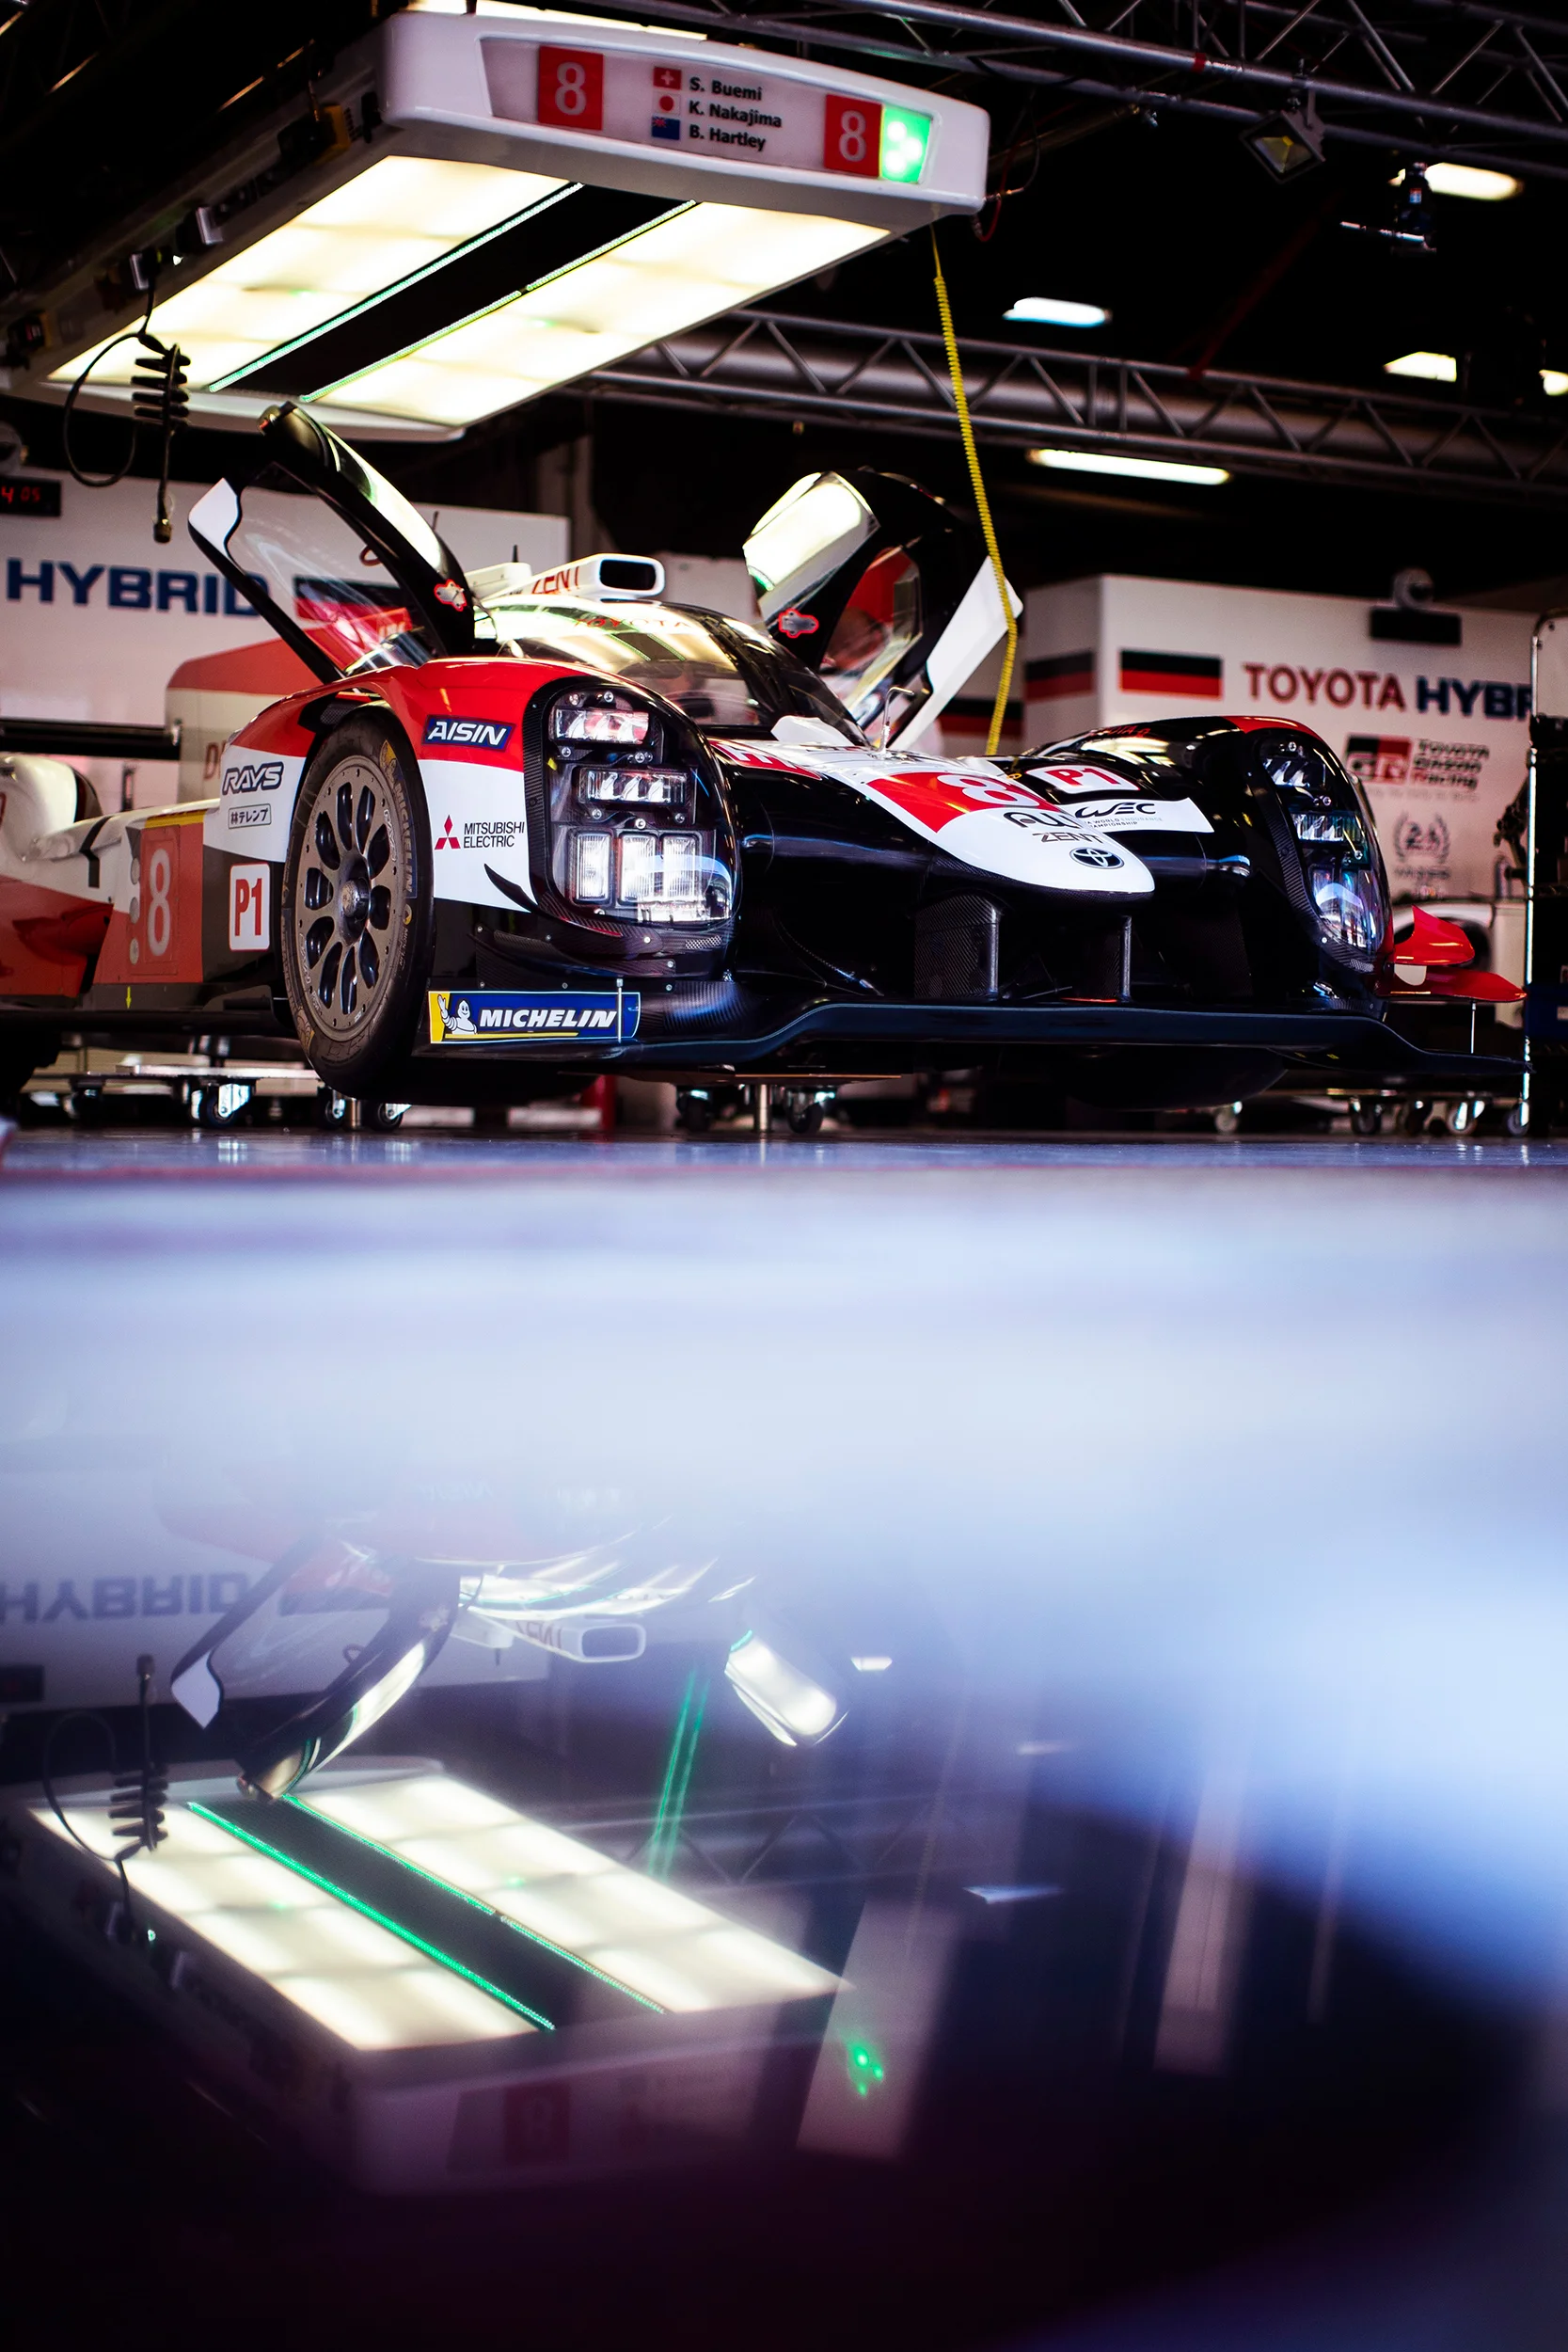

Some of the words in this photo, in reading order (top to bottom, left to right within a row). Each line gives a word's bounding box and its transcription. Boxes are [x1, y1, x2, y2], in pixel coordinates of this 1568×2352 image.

[554, 61, 587, 117] 8
[689, 76, 705, 92] S.
[711, 80, 763, 101] Buemi
[689, 101, 705, 116] K.
[709, 103, 783, 128] Nakajima
[689, 124, 705, 139] B.
[709, 127, 766, 151] Hartley
[838, 109, 866, 162] 8
[7, 558, 270, 617] HYBRID
[1243, 662, 1406, 712] TOYOTA
[428, 721, 506, 746] AISIN
[222, 761, 284, 796] RAYS
[937, 773, 1040, 806] 8
[1045, 767, 1122, 786] P1
[1074, 802, 1156, 818] WEC
[464, 821, 525, 835] MITSUBISHI
[1033, 832, 1104, 844] ZENT
[463, 835, 515, 849] ELECTRIC
[148, 848, 170, 956] 8
[234, 878, 262, 936] P1
[480, 1009, 617, 1027] MICHELIN
